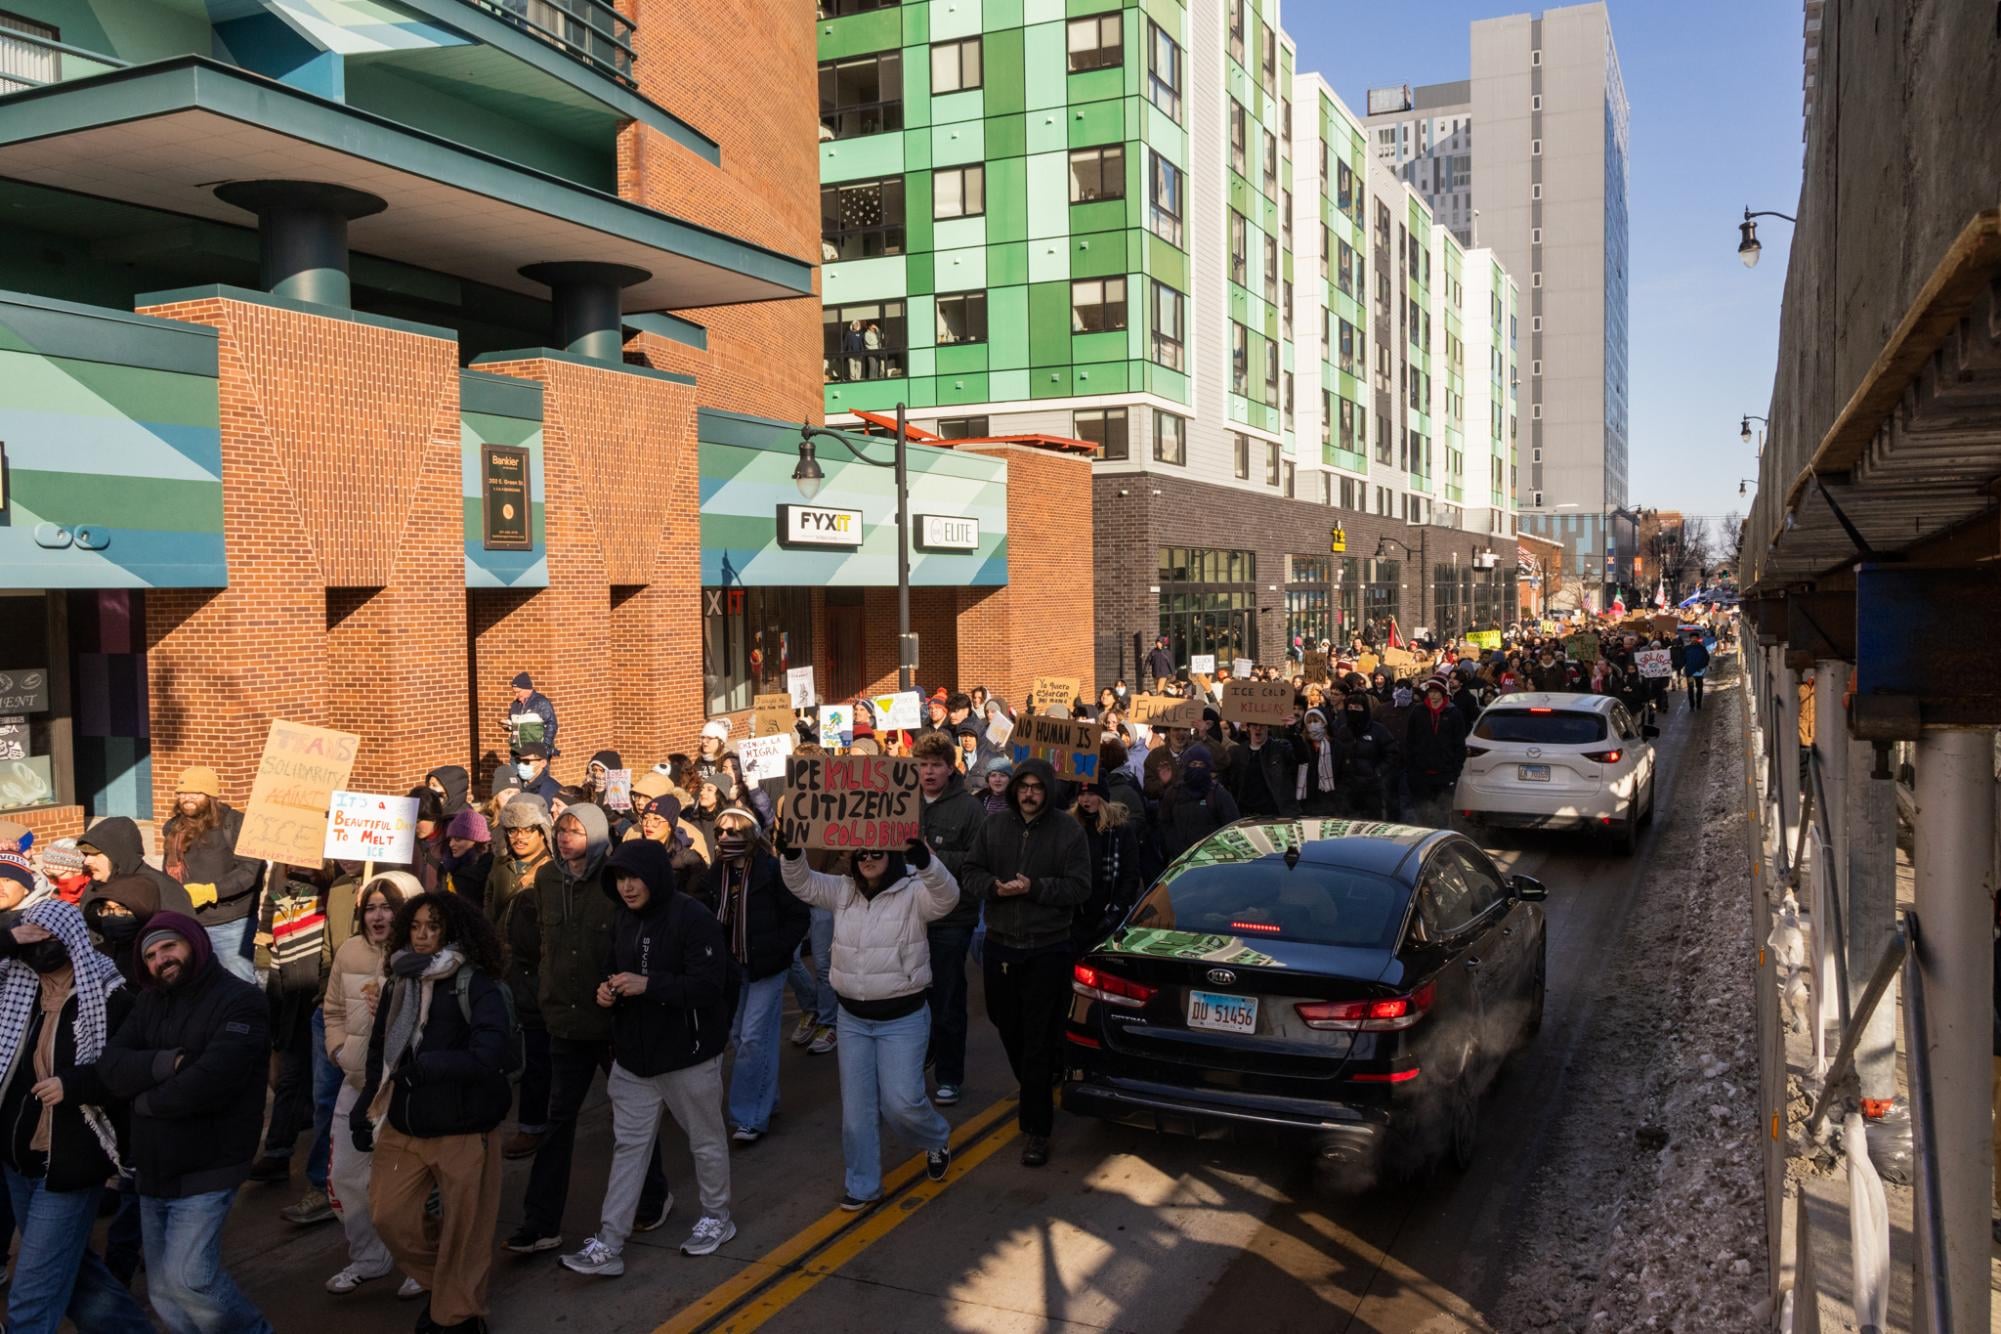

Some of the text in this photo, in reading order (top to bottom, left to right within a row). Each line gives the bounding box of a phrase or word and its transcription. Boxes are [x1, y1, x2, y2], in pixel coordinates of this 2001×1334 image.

[492, 455, 519, 466] Bankier
[801, 511, 851, 532] FYXIT
[944, 522, 972, 543] ELITE
[0, 694, 38, 709] ENT
[1231, 687, 1286, 697] ICE COLD
[1016, 717, 1092, 749] NO HUMAN IS
[275, 728, 357, 762] TRANS
[745, 746, 779, 758] MIGRA
[261, 755, 345, 790] SOLIDARITY
[787, 756, 919, 793] ICE KILLS US
[792, 790, 911, 822] CITIZENS
[334, 810, 391, 831] BEAUTIFUL
[786, 817, 810, 845] IN
[360, 830, 395, 846] MELT
[367, 846, 384, 857] ICE
[642, 937, 651, 976] SPYDE
[1210, 971, 1233, 983] KIA
[1192, 1001, 1253, 1026] DU 51456
